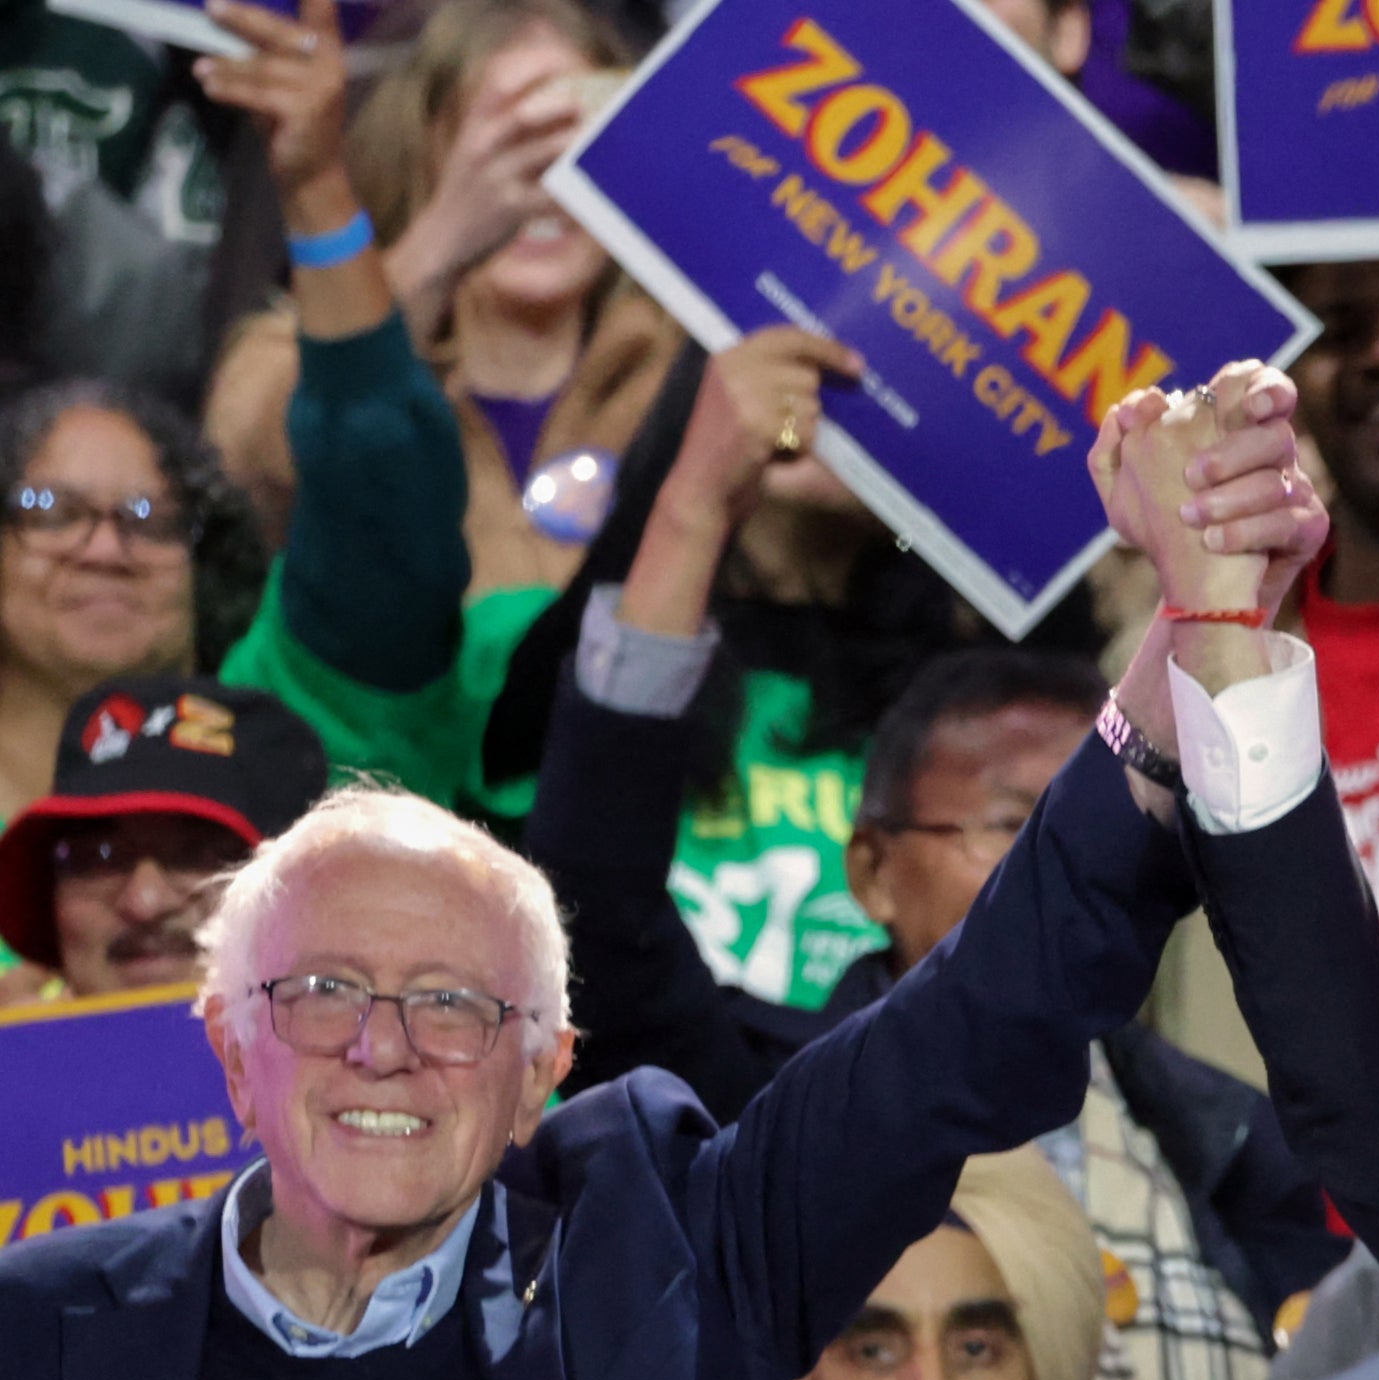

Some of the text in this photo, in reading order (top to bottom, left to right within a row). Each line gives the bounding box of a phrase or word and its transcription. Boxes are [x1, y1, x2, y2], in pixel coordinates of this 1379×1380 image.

[733, 16, 1175, 430] ZOHRAN
[771, 173, 878, 274] NEW
[873, 262, 982, 378] YORK
[973, 364, 1072, 456] CITY
[63, 1116, 231, 1177] HINDUS
